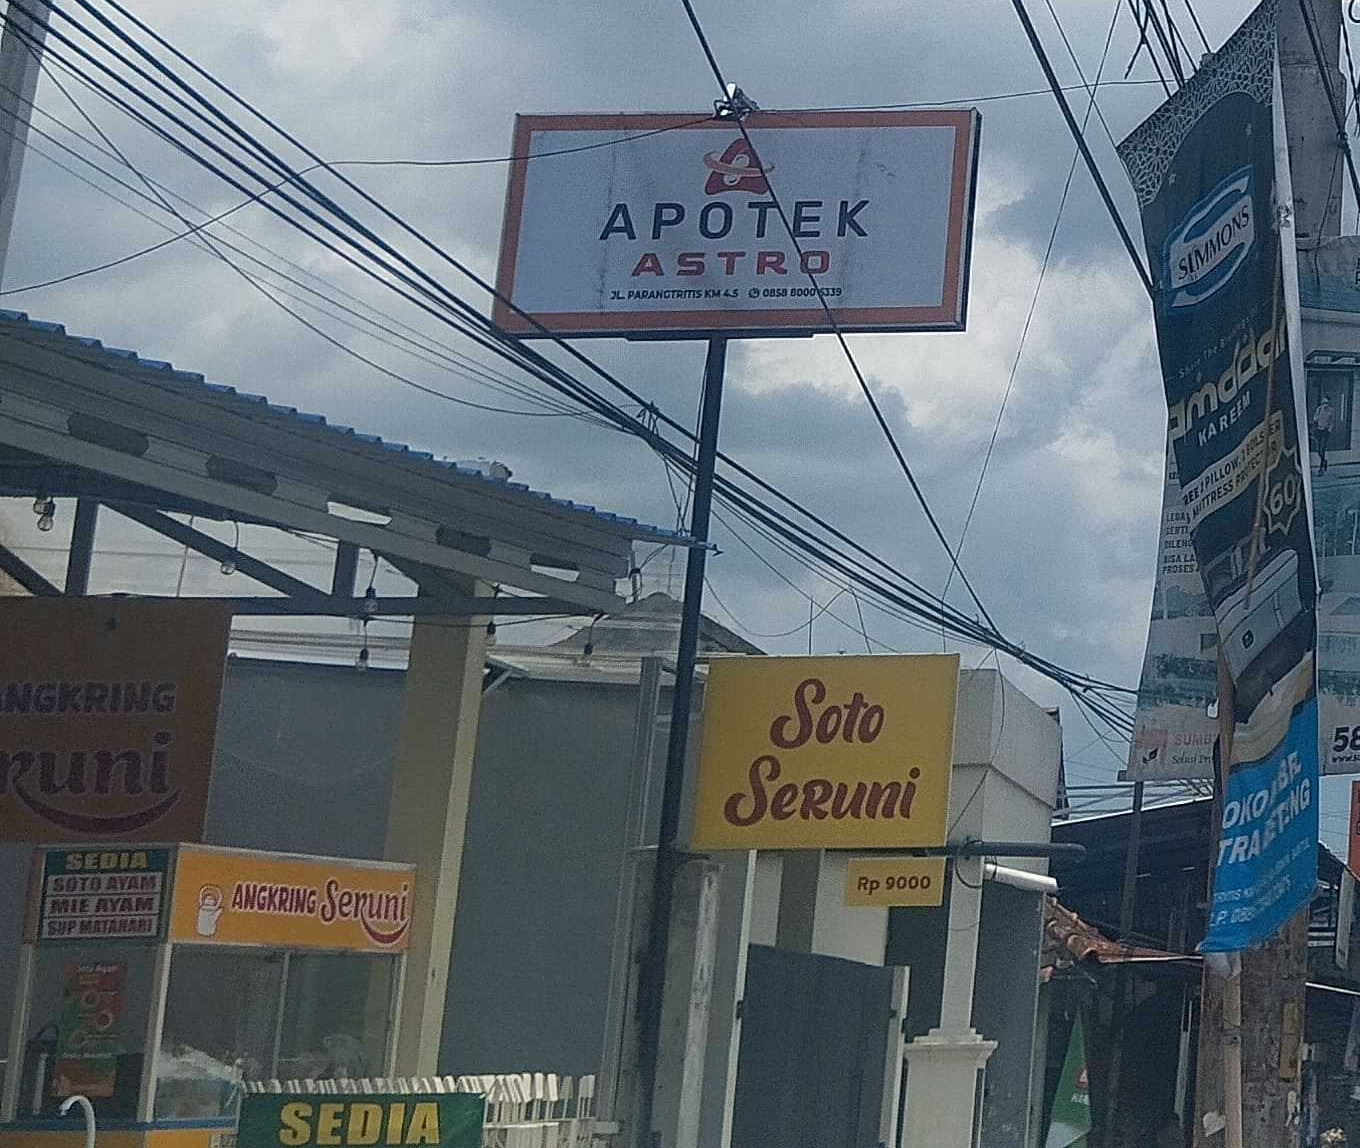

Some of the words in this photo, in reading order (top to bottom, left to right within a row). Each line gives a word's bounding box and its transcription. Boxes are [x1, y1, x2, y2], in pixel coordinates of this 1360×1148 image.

[600, 200, 869, 240] APOTEK
[1178, 204, 1250, 280] SIMMONS
[631, 250, 831, 276] ASTRO
[610, 290, 625, 300] JL.
[627, 289, 702, 300] PARANGTRITIS
[704, 289, 721, 299] KM
[762, 288, 787, 298] 0858
[790, 288, 815, 297] 8000
[1198, 390, 1251, 447] KAREEM
[1182, 486, 1200, 506] REE
[1167, 511, 1186, 522] LEGA
[1165, 526, 1188, 535] SERTI
[1162, 565, 1195, 574] PROSES
[769, 678, 885, 749] Soto
[1174, 733, 1215, 746] SUMB
[0, 731, 181, 834] runi
[1222, 789, 1269, 829] OKO
[65, 852, 147, 870] SEDIA
[53, 877, 101, 892] SOTO
[105, 875, 156, 890] AYAM
[857, 877, 880, 895] Rp
[886, 875, 931, 890] 9000
[51, 898, 90, 914] MIE
[95, 897, 153, 912] AYAM
[231, 882, 317, 915] ANGKRING
[320, 878, 409, 945] Seruni
[47, 920, 77, 935] SUP
[79, 918, 153, 934] MATAHARI
[279, 1102, 441, 1146] SEDIA
